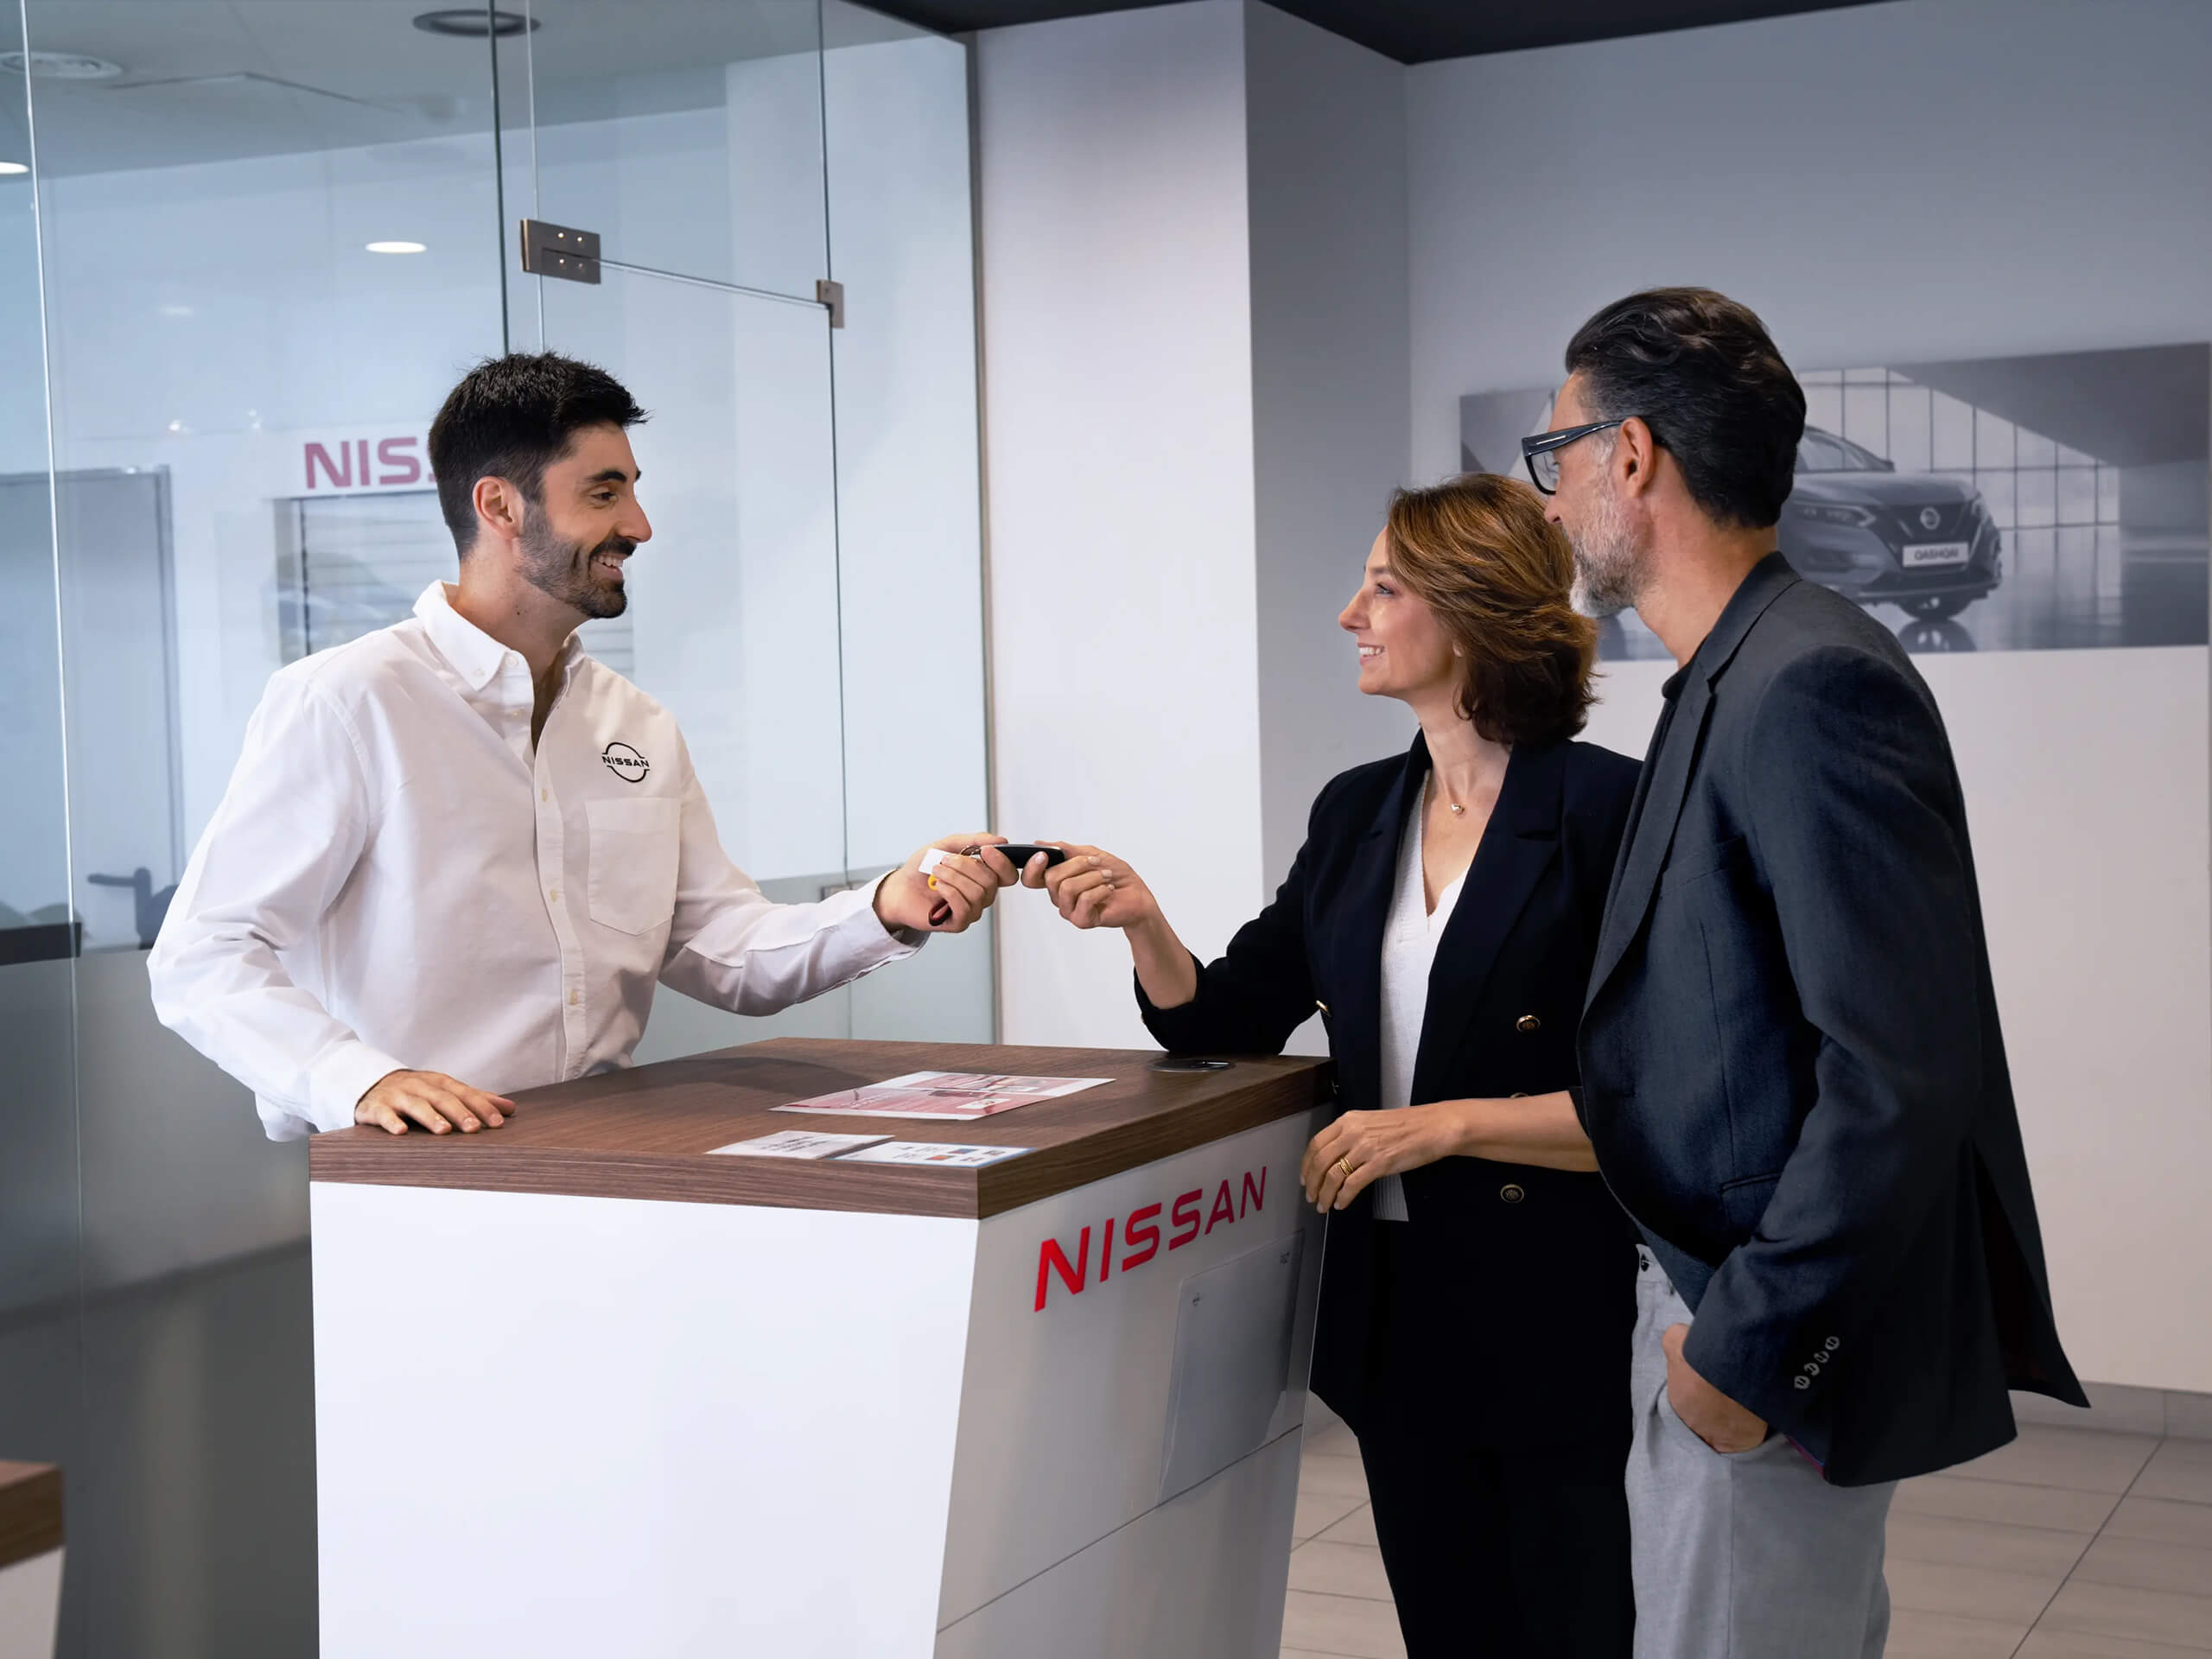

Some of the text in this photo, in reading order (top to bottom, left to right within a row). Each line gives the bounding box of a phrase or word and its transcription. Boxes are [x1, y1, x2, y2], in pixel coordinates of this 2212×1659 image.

[305, 436, 436, 489] NIS
[601, 755, 650, 767] NISSAN
[1034, 1166, 1267, 1312] NISSAN
